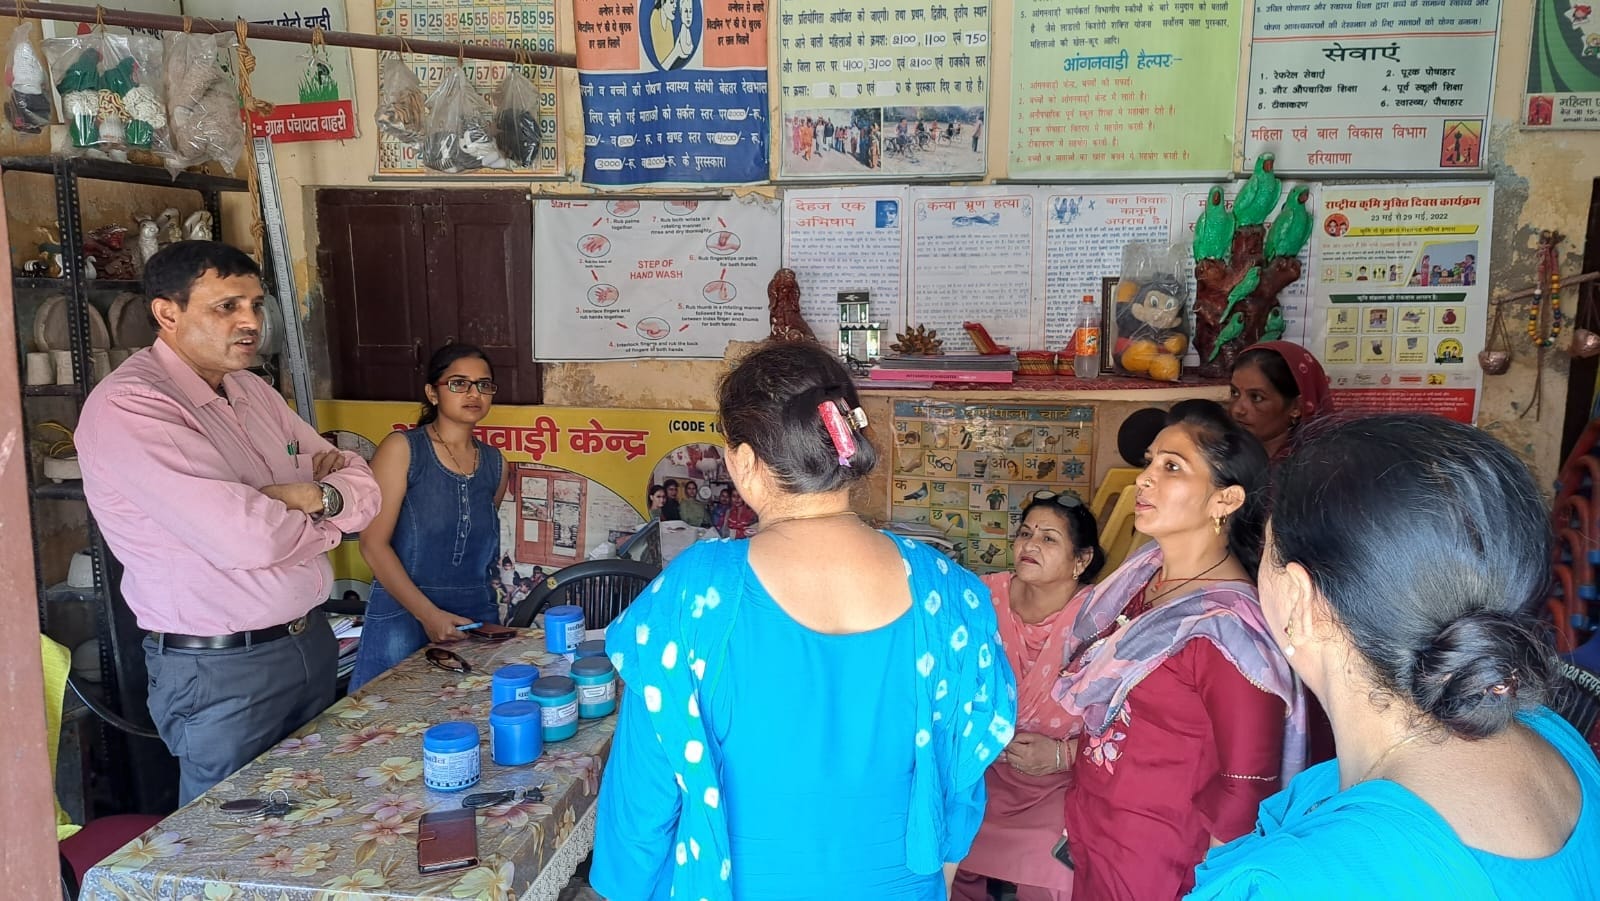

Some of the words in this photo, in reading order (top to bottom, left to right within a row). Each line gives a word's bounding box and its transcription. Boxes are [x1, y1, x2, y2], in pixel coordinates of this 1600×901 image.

[399, 13, 408, 27] 5
[414, 13, 426, 27] 15
[428, 13, 442, 27] 25
[444, 13, 458, 27] 35
[459, 12, 473, 26] 45
[475, 12, 488, 26] 55
[490, 11, 504, 26] 65
[507, 11, 520, 24] 75
[522, 11, 536, 24] 85
[539, 11, 554, 25] 95
[782, 11, 793, 25] खेल
[798, 9, 824, 24] प्रतियोगिता
[830, 9, 852, 23] आयोजित
[895, 10, 906, 20] तथा
[954, 4, 968, 22] तृतीय
[973, 6, 987, 17] स्थान
[522, 38, 537, 51] 86
[539, 38, 554, 52] 96
[810, 34, 823, 47] वाली
[925, 34, 946, 45] 1100
[966, 34, 987, 44] 750
[1322, 42, 1400, 62] सेवाएं
[783, 57, 792, 73] और
[797, 59, 811, 72] जिला
[816, 61, 825, 72] स्तर
[831, 61, 838, 71] पर
[869, 59, 892, 70] 3100
[949, 53, 970, 68] राजकीय
[975, 56, 986, 67] स्तर
[1063, 49, 1129, 72] आंगनवाड़ी
[429, 67, 443, 80] 27
[476, 66, 489, 80] 57
[492, 65, 505, 79] 67
[523, 65, 537, 79] 87
[540, 65, 554, 79] 97
[1274, 70, 1298, 79] रेफरेल
[1401, 68, 1420, 78] पूरक
[1425, 66, 1456, 76] पोषाहार
[666, 81, 689, 93] स्वास्थ्य
[694, 79, 714, 93] संबंधी
[719, 78, 737, 94] बेहतर
[741, 77, 768, 93] देखभाल
[916, 82, 936, 96] पुरस्कार
[940, 78, 950, 93] दिए
[954, 82, 961, 92] जा
[965, 77, 973, 92] रहे
[1292, 84, 1332, 94] औपचारिक
[1337, 83, 1358, 93] शिक्षा
[1397, 82, 1410, 93] पूर्व
[1415, 82, 1437, 93] स्कूली
[1443, 82, 1463, 92] शिक्षा
[541, 92, 555, 106] 98
[1272, 100, 1308, 109] टीकाकरण
[1560, 96, 1592, 107] महिला
[589, 109, 604, 125] लिए
[608, 108, 621, 127] चुनी
[676, 104, 695, 120] सर्कल
[700, 109, 713, 120] स्तर
[265, 120, 285, 136] ग्राम
[287, 113, 318, 133] पंचायत
[541, 120, 555, 133] 99
[688, 132, 701, 143] स्तर
[1250, 126, 1283, 141] महिला
[1292, 125, 1307, 141] एवं
[1317, 128, 1338, 139] बाल
[1347, 124, 1383, 139] विकास
[1392, 124, 1427, 139] विभाग
[541, 147, 556, 160] 100
[551, 200, 571, 209] Start
[841, 202, 866, 212] एक
[928, 201, 957, 212] कन्या
[994, 199, 1020, 209] हत्या
[1105, 197, 1128, 205] बाल
[1326, 199, 1356, 212] राष्ट्रीय
[1411, 197, 1437, 208] दिवस
[1440, 195, 1480, 208] कार्यक्रम
[1382, 213, 1392, 221] मई
[638, 260, 660, 269] STEP
[662, 259, 674, 268] OF
[630, 271, 653, 280] HAND
[655, 270, 683, 280] WASH
[669, 420, 706, 434] (CODE
[568, 418, 650, 461] केन्द्र
